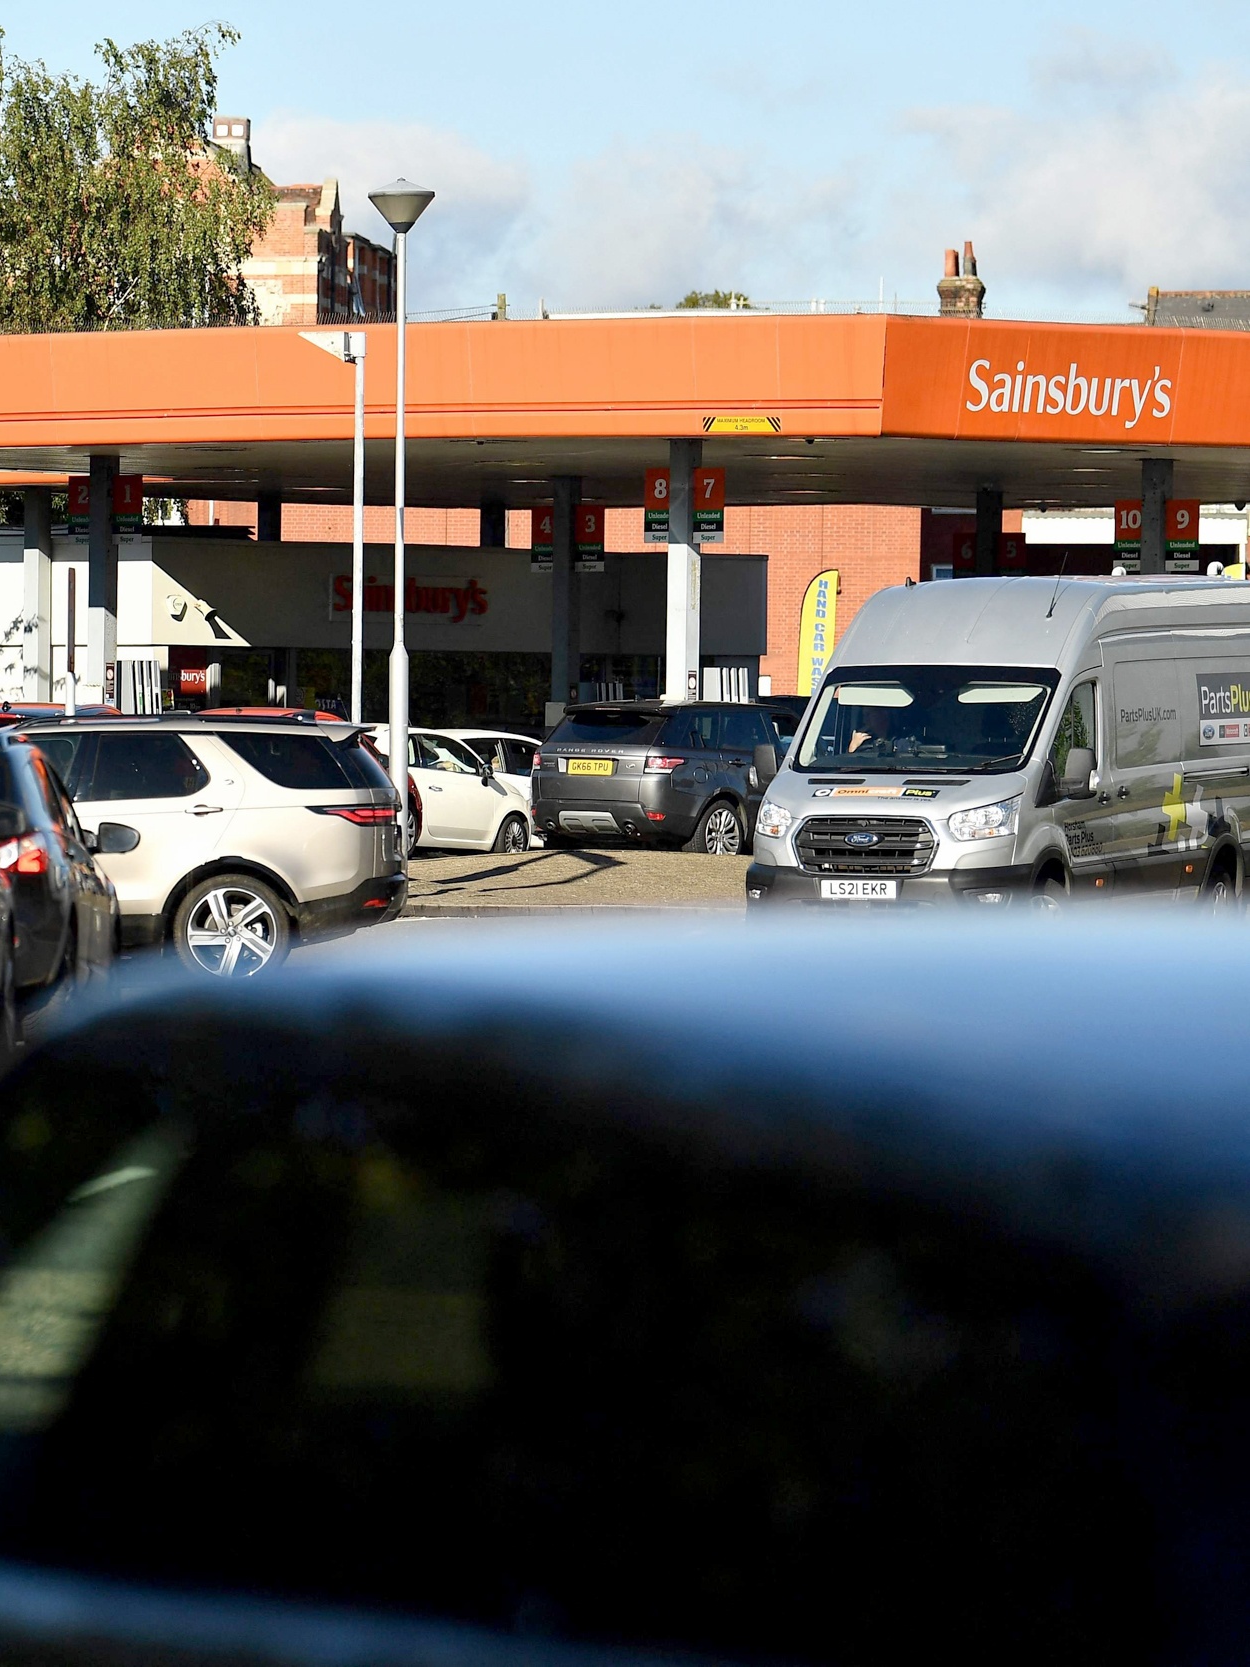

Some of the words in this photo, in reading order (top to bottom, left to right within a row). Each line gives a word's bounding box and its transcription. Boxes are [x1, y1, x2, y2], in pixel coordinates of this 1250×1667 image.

[966, 359, 1172, 429] Sainsbury's
[78, 486, 89, 504] 2
[124, 485, 132, 503] 1
[654, 478, 667, 499] 8
[703, 478, 715, 499] 7
[540, 516, 552, 534] 4
[585, 515, 596, 533] 3
[1120, 509, 1142, 529] 10
[1176, 509, 1190, 529] 9
[651, 533, 667, 541] Super
[700, 533, 716, 541] Super
[333, 574, 489, 624] Sinbury's
[815, 579, 828, 618] HAND
[813, 623, 825, 652] CAR
[1200, 684, 1250, 715] PartsPlu
[1120, 706, 1177, 723] PartsPlusUK.com
[571, 762, 592, 771] GK66
[593, 762, 609, 772] TPU
[905, 789, 933, 797] Plus
[850, 834, 870, 844] Ford
[1081, 830, 1094, 844] Plus
[829, 882, 859, 896] LS21
[862, 882, 888, 896] EKR
